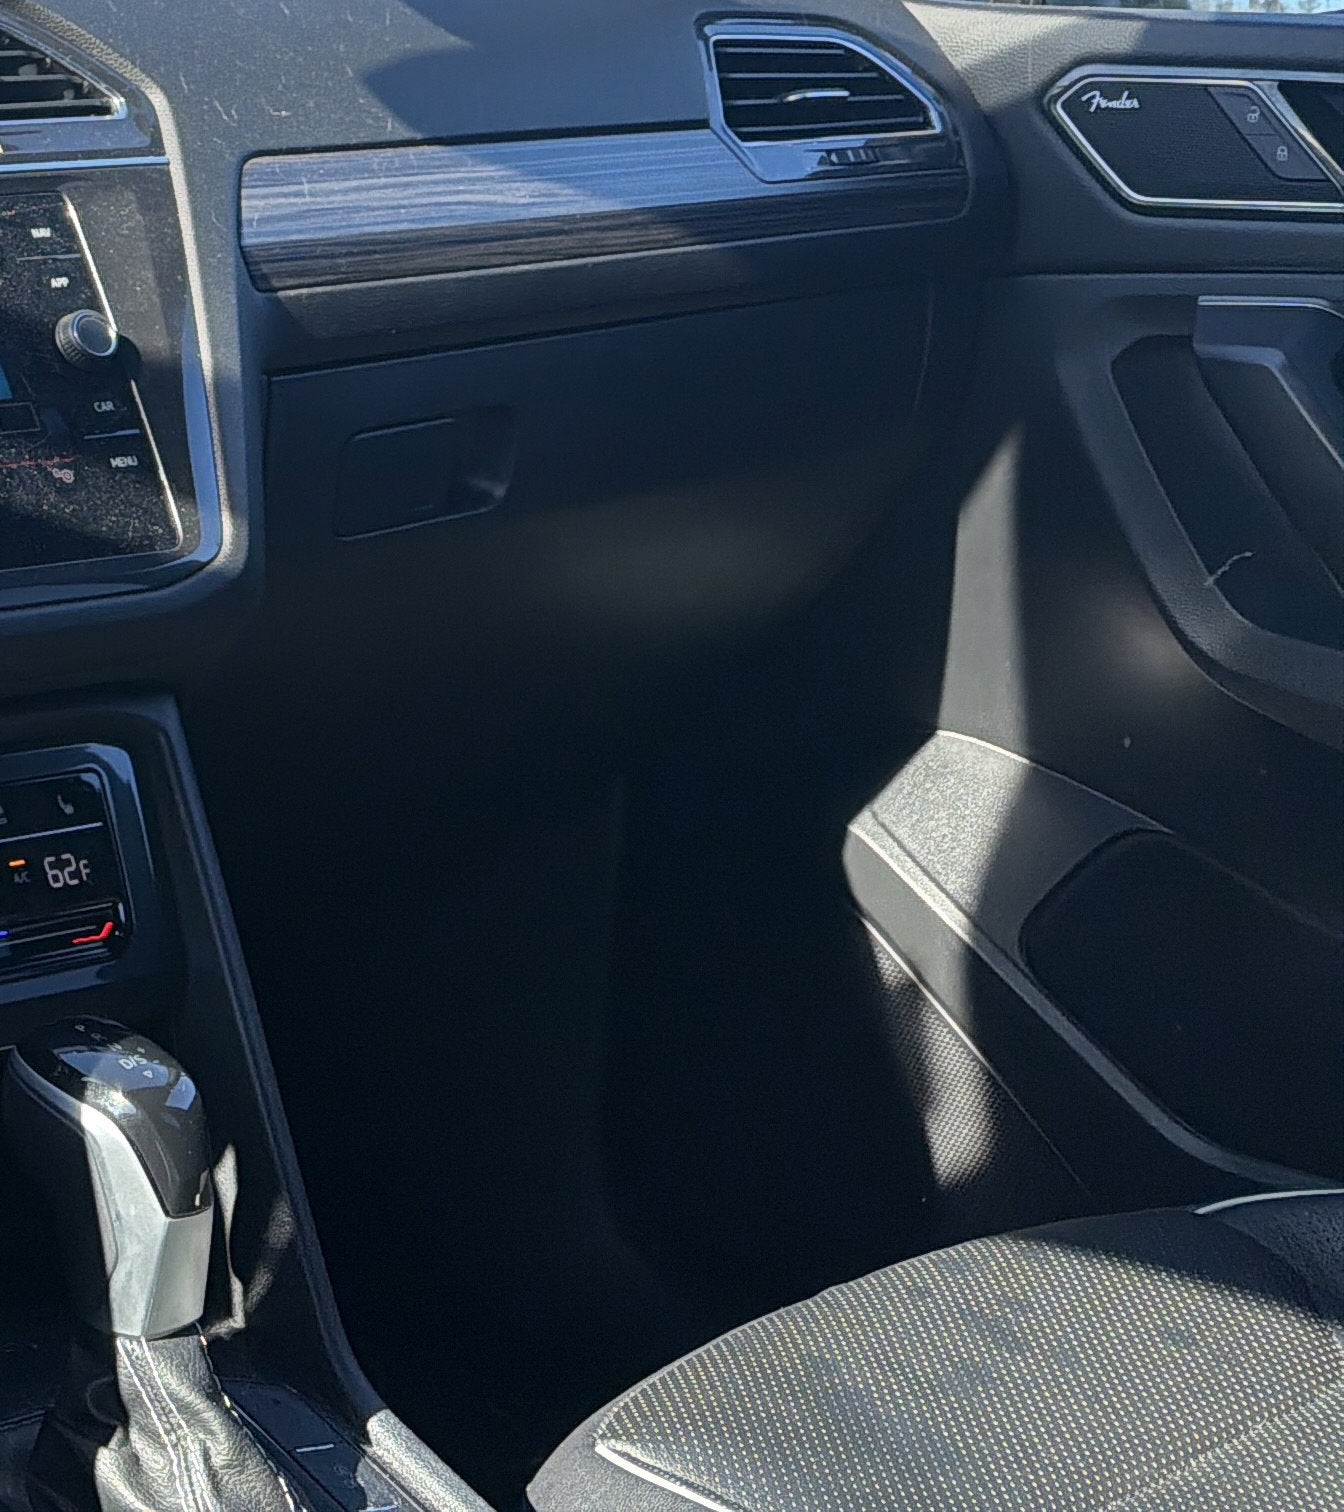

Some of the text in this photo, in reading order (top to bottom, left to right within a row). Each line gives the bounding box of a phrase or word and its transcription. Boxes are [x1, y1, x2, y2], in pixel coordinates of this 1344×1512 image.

[1081, 90, 1140, 113] Fender
[31, 228, 51, 238] NAV
[51, 278, 69, 288] APP
[93, 401, 115, 412] CAR
[109, 456, 138, 469] MENU
[118, 1054, 148, 1070] D/S
